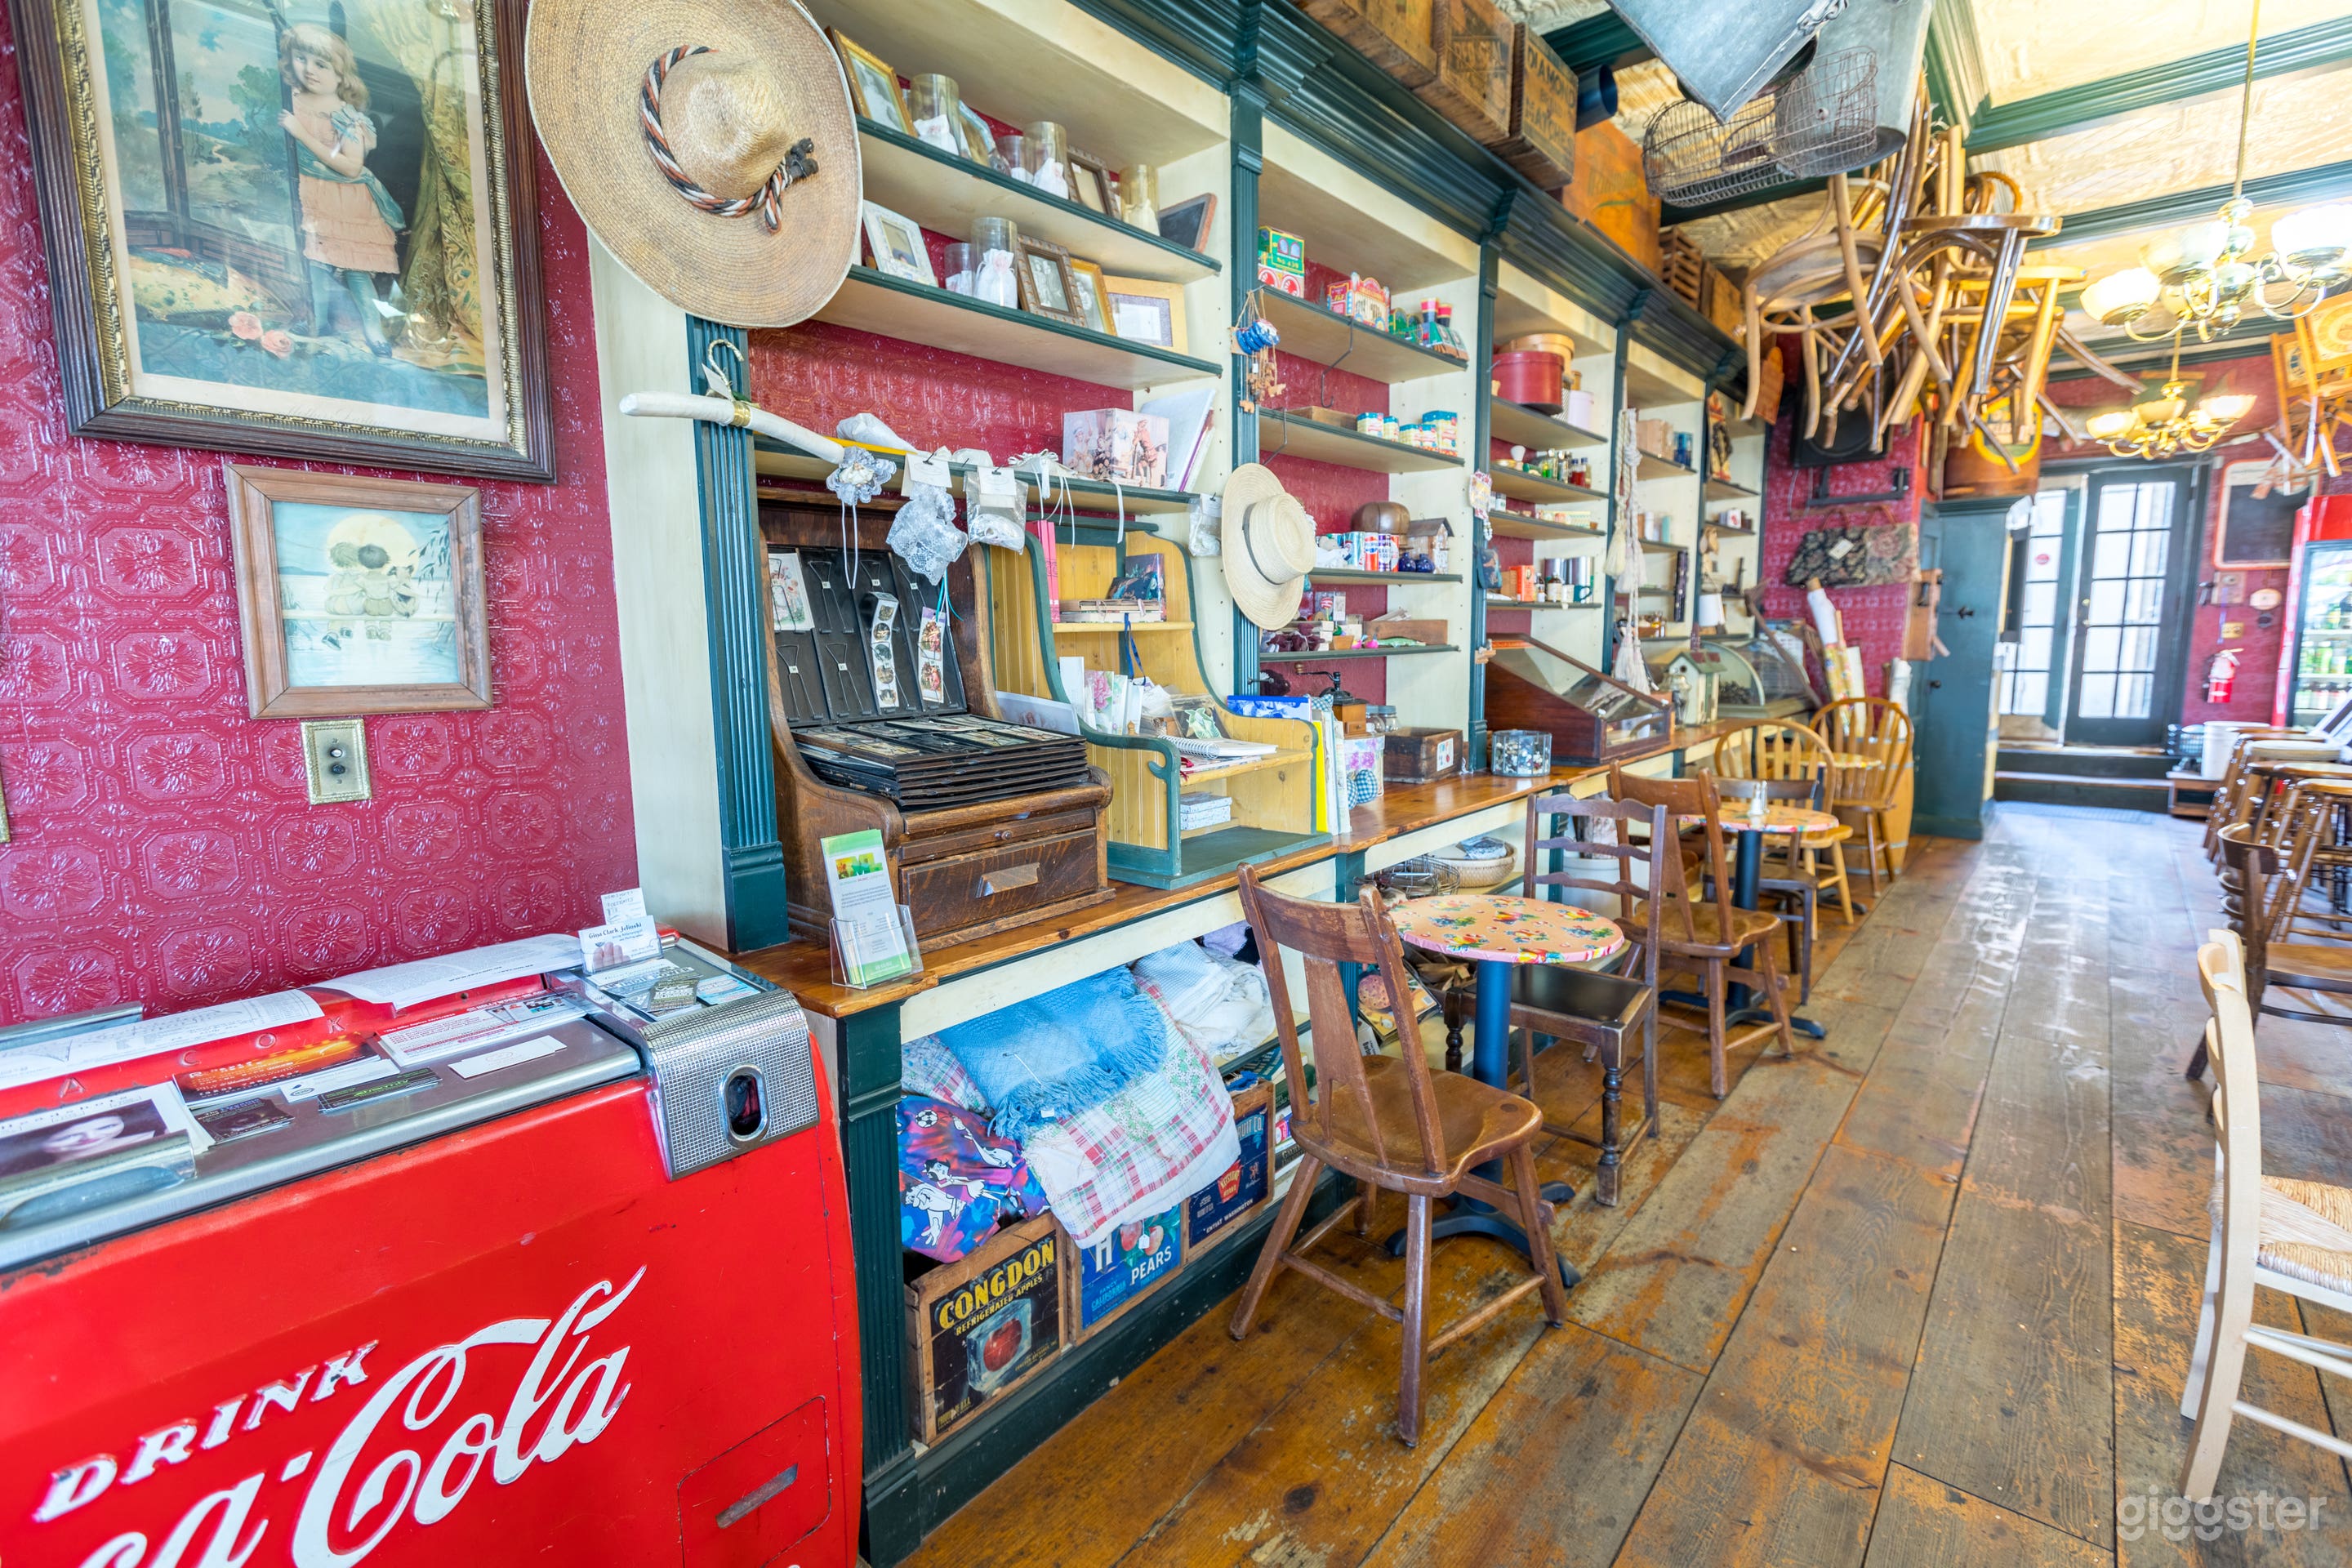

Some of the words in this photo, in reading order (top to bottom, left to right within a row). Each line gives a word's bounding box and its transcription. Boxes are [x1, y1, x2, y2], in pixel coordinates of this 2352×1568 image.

[1236, 1118, 1253, 1139] RUIT
[937, 1237, 1055, 1330] CONGDON
[1129, 1245, 1173, 1286] PEARS
[955, 1293, 1014, 1337] REFRIGERATED
[1015, 1274, 1044, 1298] APPLES
[31, 1339, 381, 1524] DRINK
